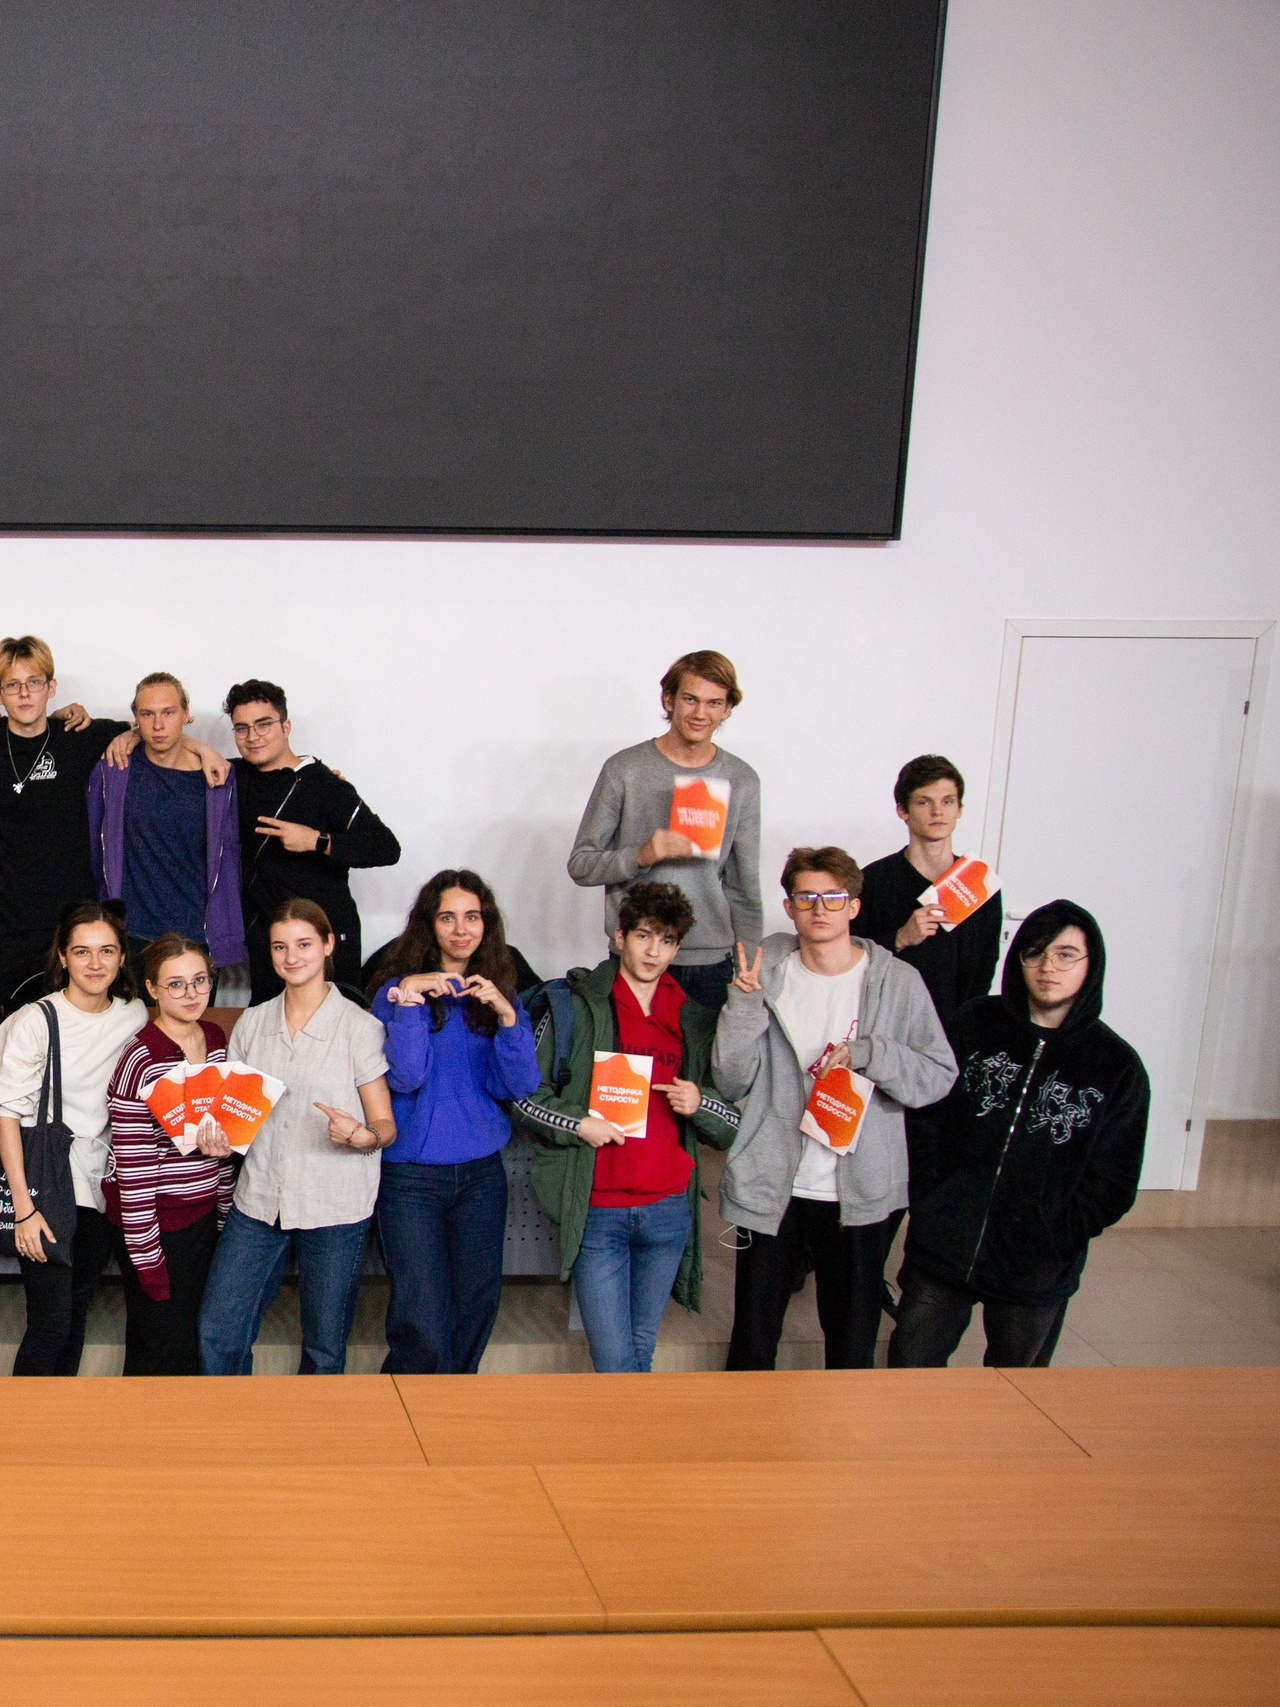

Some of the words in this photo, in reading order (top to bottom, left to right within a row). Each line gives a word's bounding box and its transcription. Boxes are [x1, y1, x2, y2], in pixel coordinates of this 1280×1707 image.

[596, 1085, 643, 1097] МЕТОДИЧКА
[599, 1094, 640, 1104] СТАРОСТЫ
[194, 1105, 211, 1113] СТА
[220, 1103, 256, 1123] СТАРОСТЫ
[222, 1094, 263, 1117] МЕТОДИЧКА
[815, 1090, 857, 1117] МЕТОДИЧКА
[816, 1100, 852, 1122] СТАРОСТЫ
